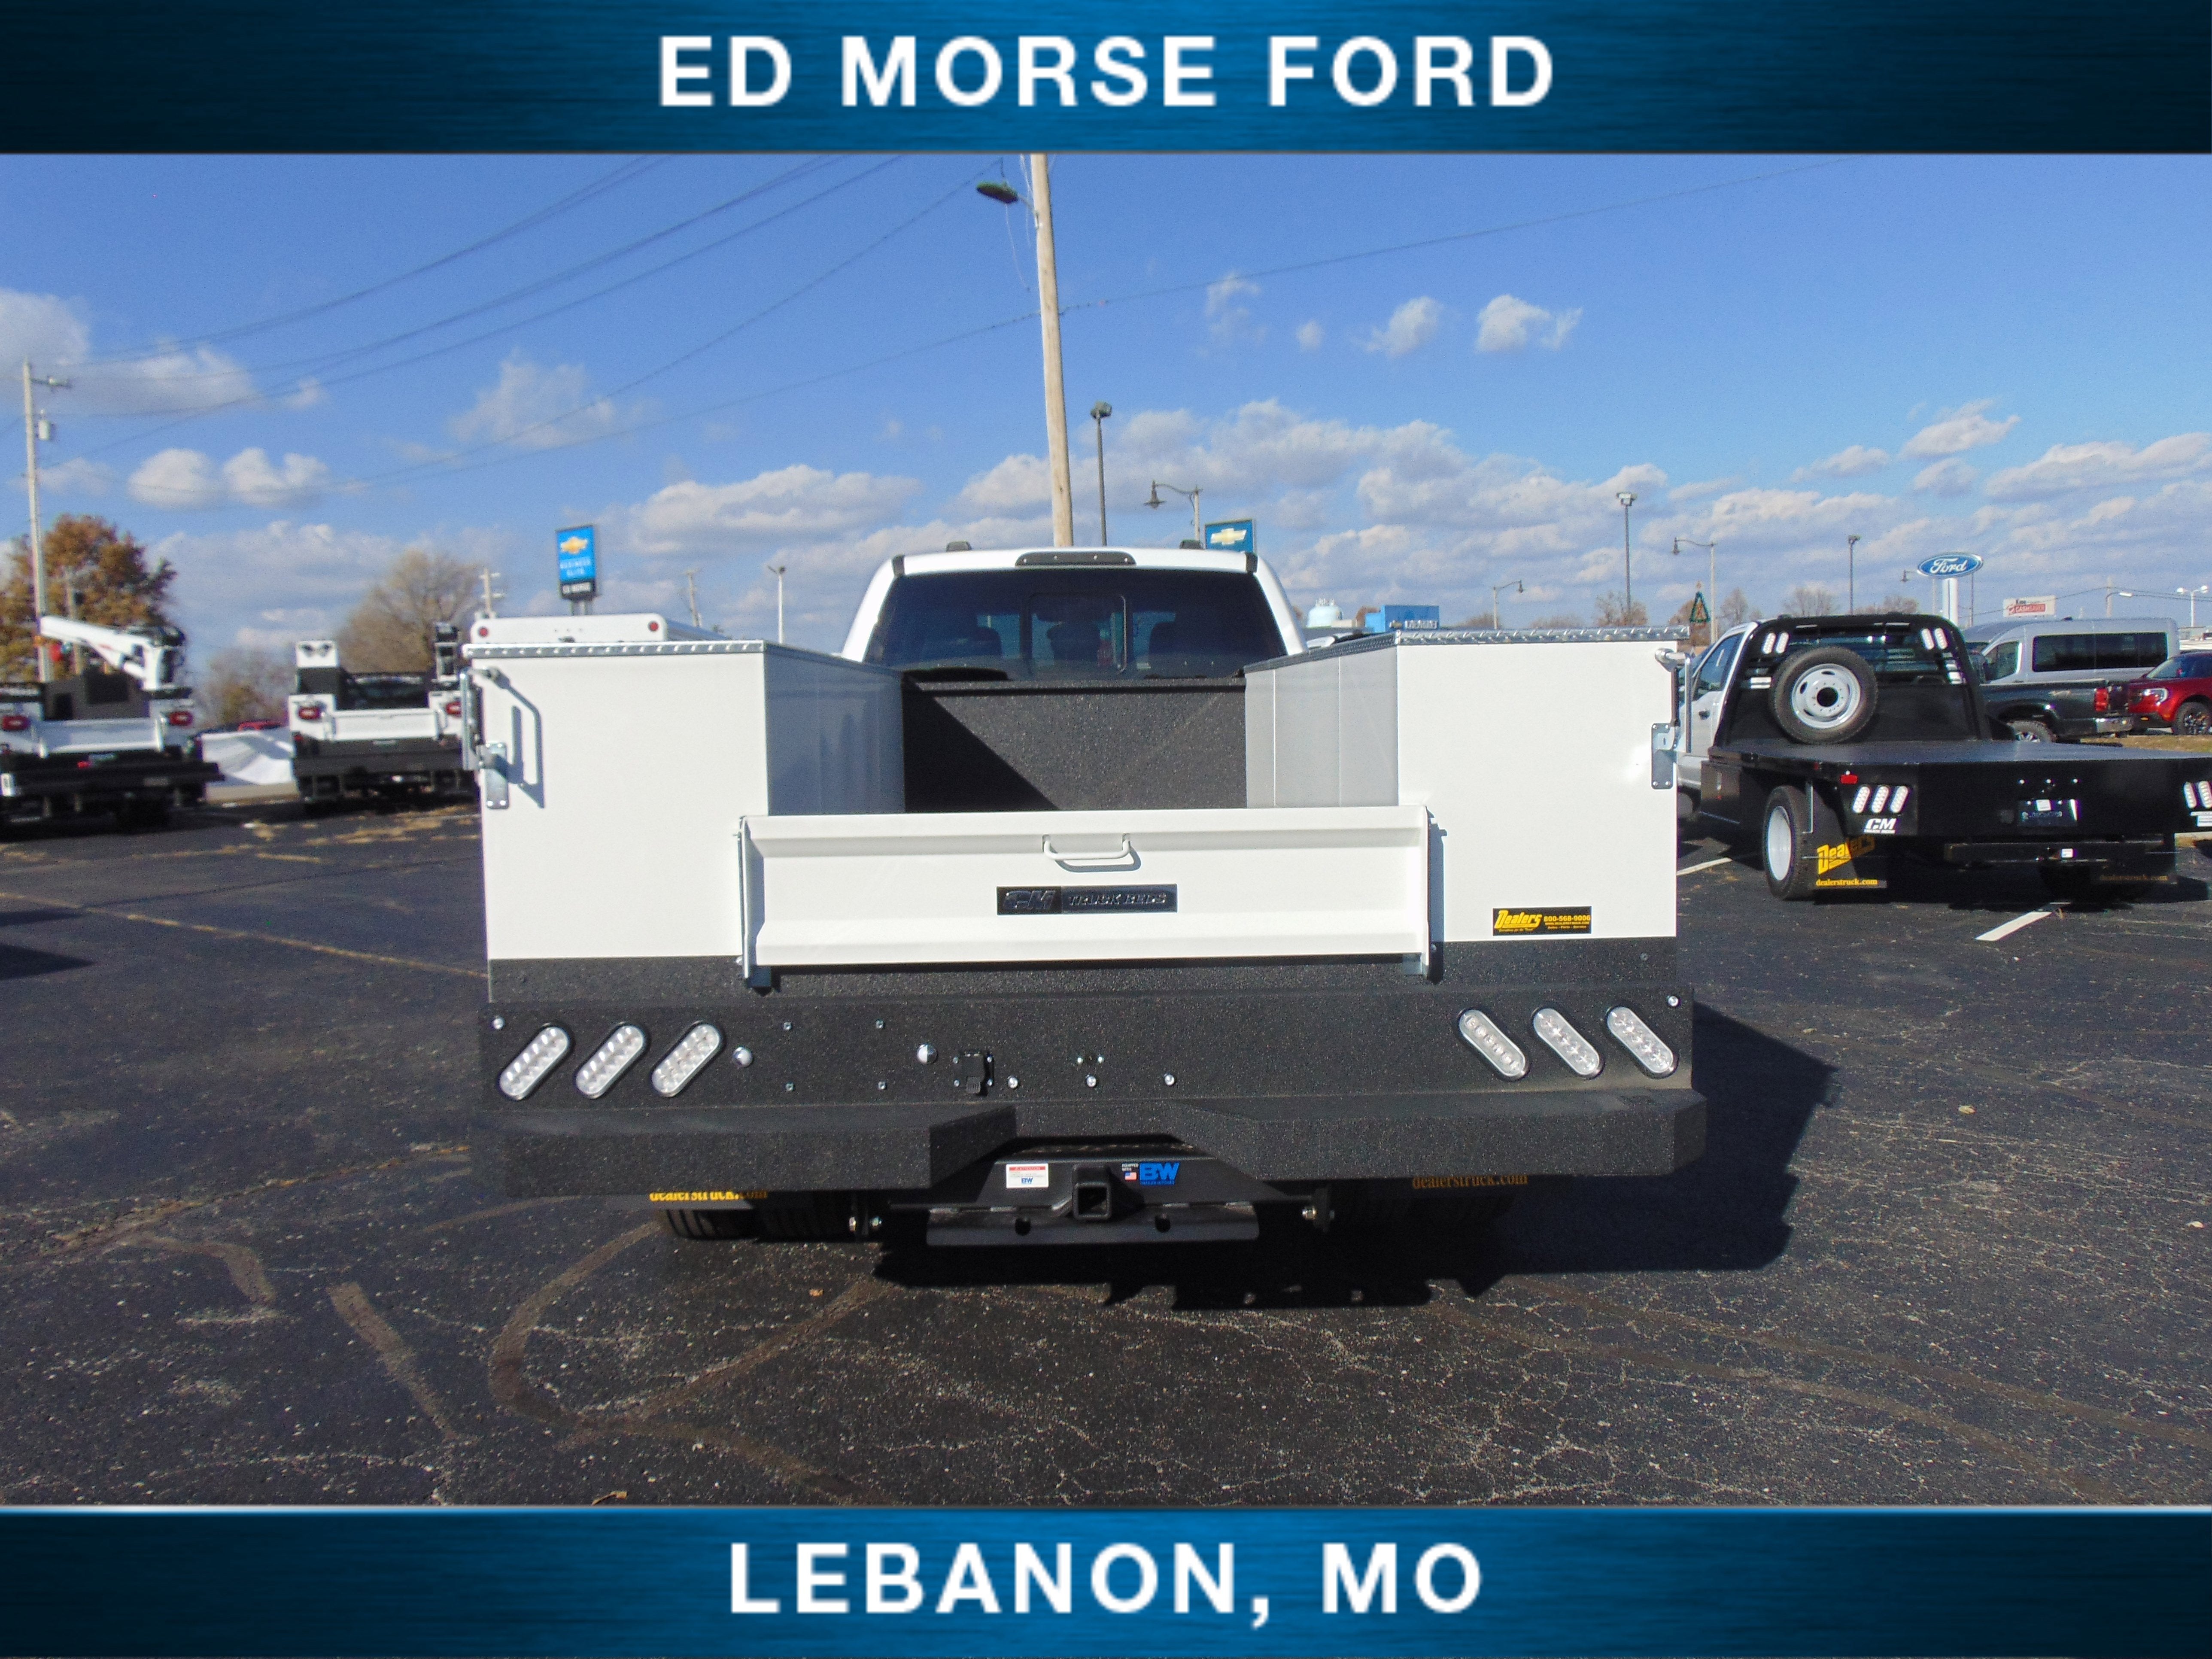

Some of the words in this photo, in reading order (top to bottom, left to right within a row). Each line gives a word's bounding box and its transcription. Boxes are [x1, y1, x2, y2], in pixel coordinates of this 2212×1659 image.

[1930, 558, 1968, 574] Ford
[1865, 818, 1897, 830] CM
[1815, 878, 1878, 887] dealerstruck.com
[1494, 910, 1543, 929] Dealers
